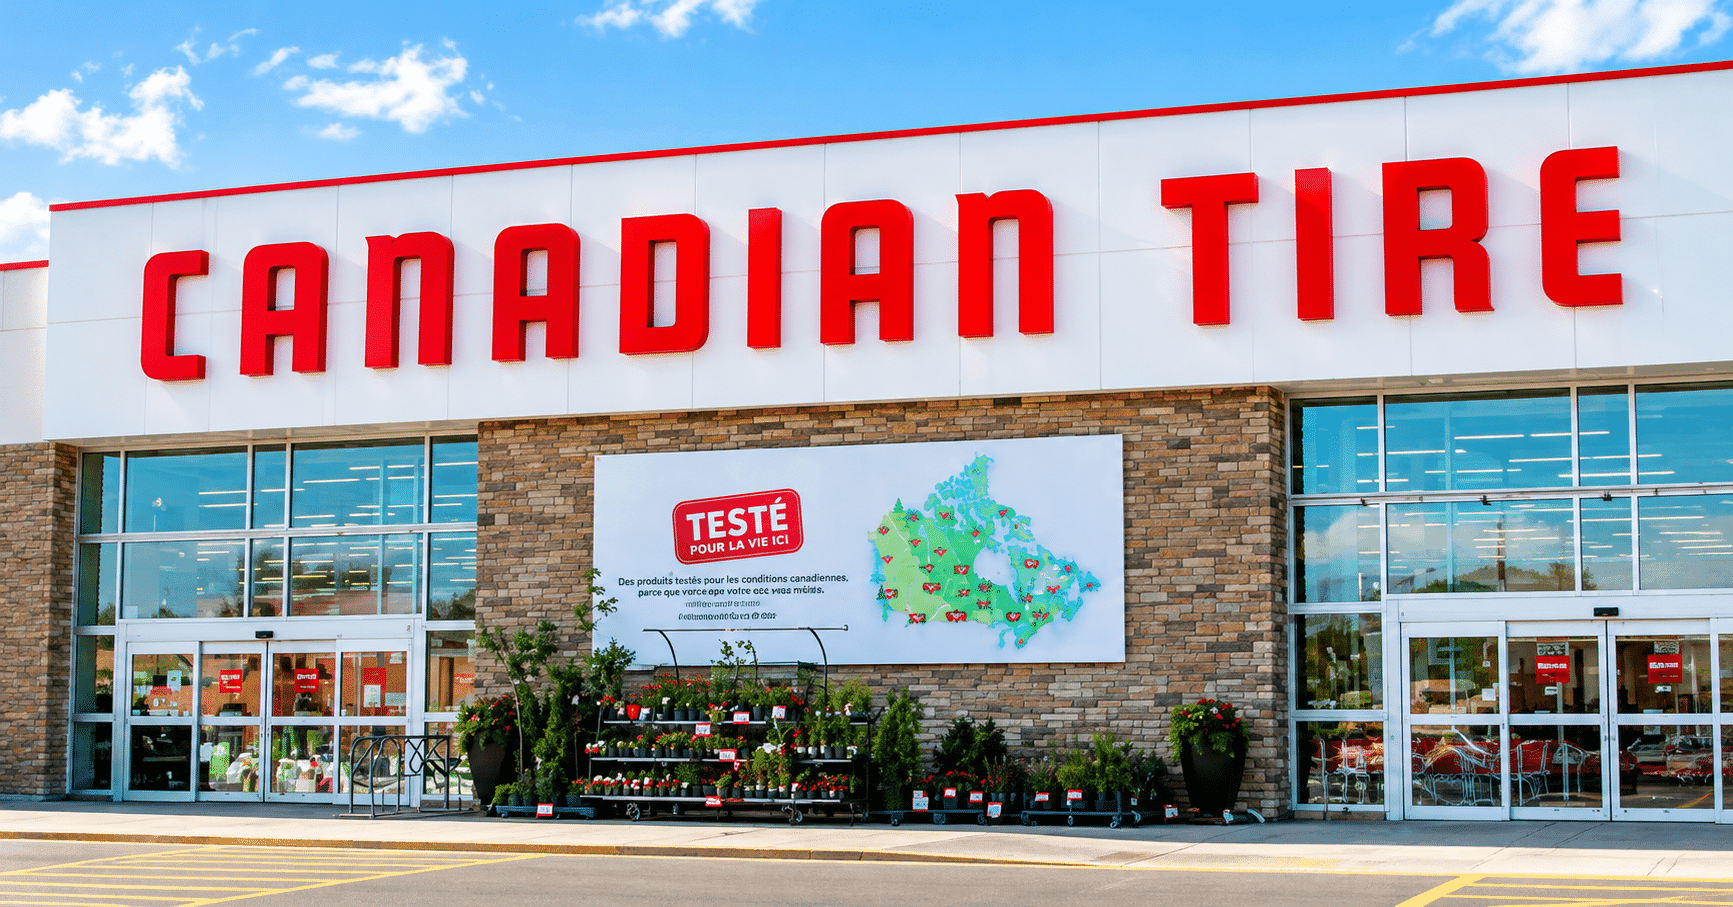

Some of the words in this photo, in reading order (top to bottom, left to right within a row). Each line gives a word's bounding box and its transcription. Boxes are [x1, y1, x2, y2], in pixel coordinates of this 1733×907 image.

[140, 189, 1056, 383] CANADIAN
[1160, 146, 1624, 327] TIRE
[685, 496, 788, 541] TESTÉ
[689, 542, 725, 555] POUR
[728, 540, 745, 551] LA
[748, 537, 768, 548] VIE
[772, 534, 789, 545] ICI
[618, 577, 635, 586] Des
[637, 576, 674, 587] produits
[675, 575, 702, 585] testés
[704, 577, 724, 586] pour
[726, 575, 740, 584] les
[741, 574, 788, 584] conditions
[638, 589, 662, 598] parce
[663, 588, 680, 598] que
